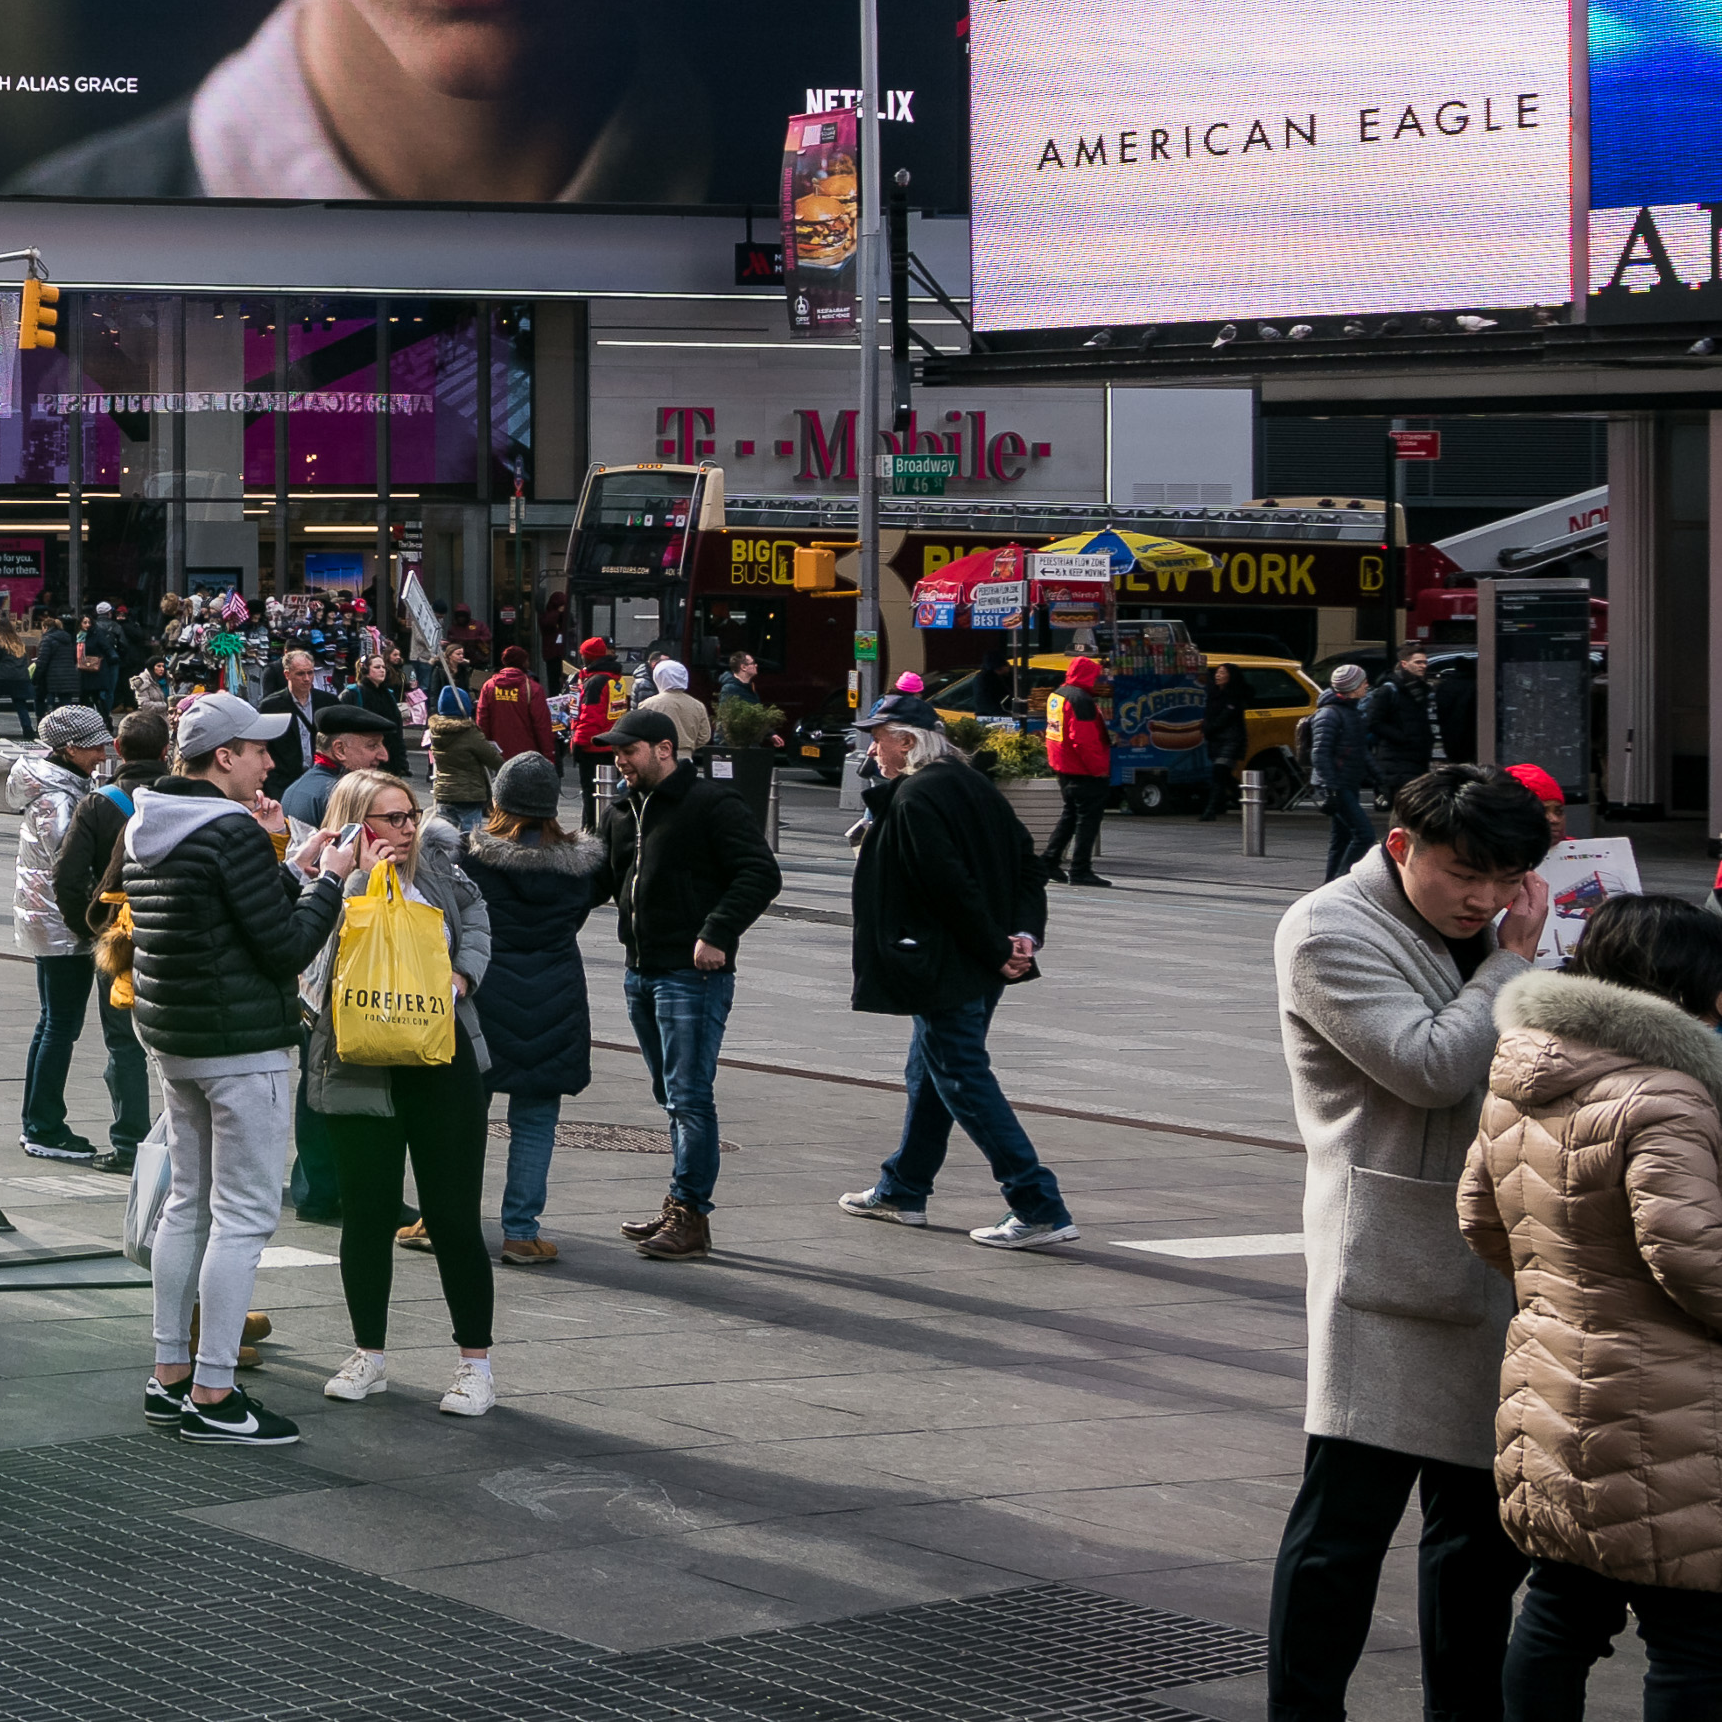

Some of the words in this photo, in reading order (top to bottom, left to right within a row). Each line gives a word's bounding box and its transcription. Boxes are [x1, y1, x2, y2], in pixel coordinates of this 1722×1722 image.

[15, 75, 71, 93] ALIAS
[74, 76, 139, 94] GRACE
[1036, 112, 1319, 172] AMERICAN
[1357, 91, 1542, 144] EAGLE
[895, 457, 956, 478] Broadway
[895, 477, 906, 492] W
[912, 477, 929, 493] 46
[2, 553, 16, 563] for
[16, 554, 34, 566] you.
[731, 539, 771, 563] BIG
[2, 565, 16, 575] for
[15, 565, 40, 575] them.
[1039, 557, 1073, 566] PEDESTRIAN
[1074, 557, 1090, 566] FLOW
[1091, 558, 1106, 567] ZONE
[731, 563, 771, 585] BUS
[1068, 569, 1083, 577] KEEP
[1084, 569, 1106, 577] MOVING
[1211, 553, 1317, 596] YORK
[973, 615, 1000, 627] BEST
[429, 995, 446, 1016] 21
